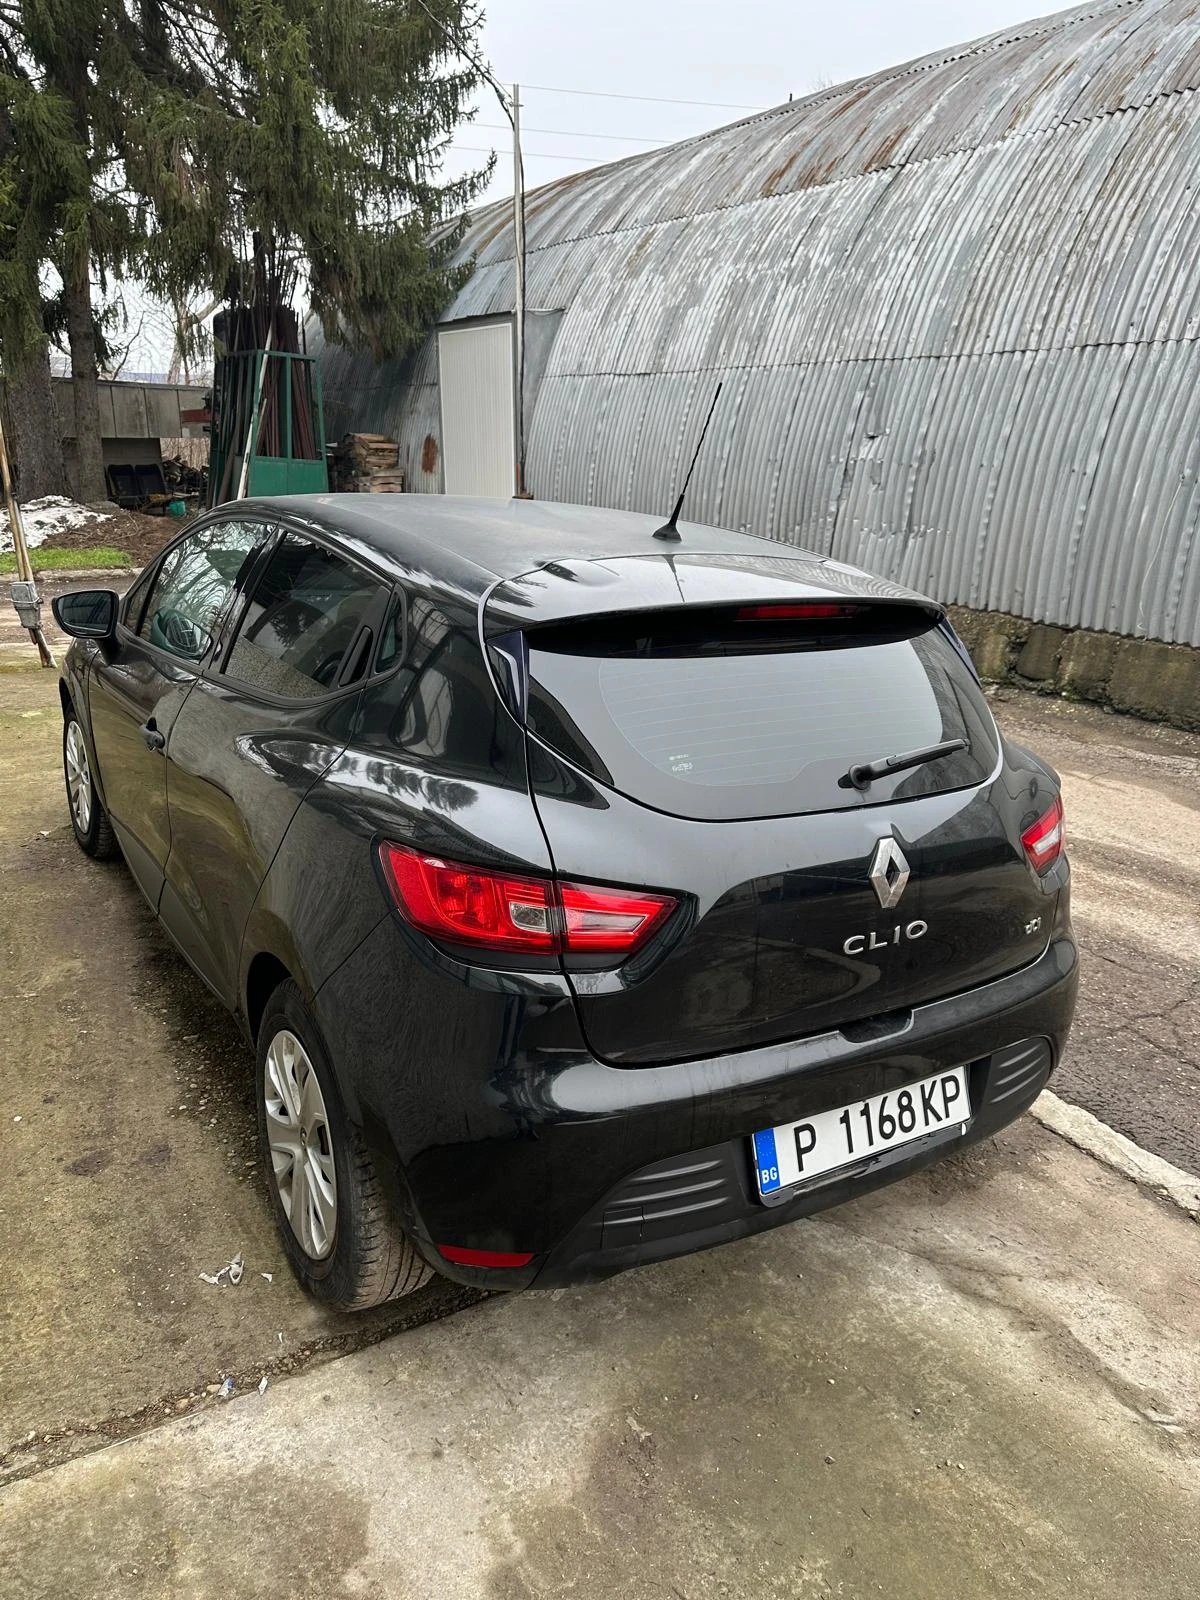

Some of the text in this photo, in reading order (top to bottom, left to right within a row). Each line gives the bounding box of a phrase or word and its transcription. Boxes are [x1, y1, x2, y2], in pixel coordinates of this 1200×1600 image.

[843, 919, 928, 955] CLIO
[793, 1122, 817, 1173] P
[761, 1166, 778, 1184] BG
